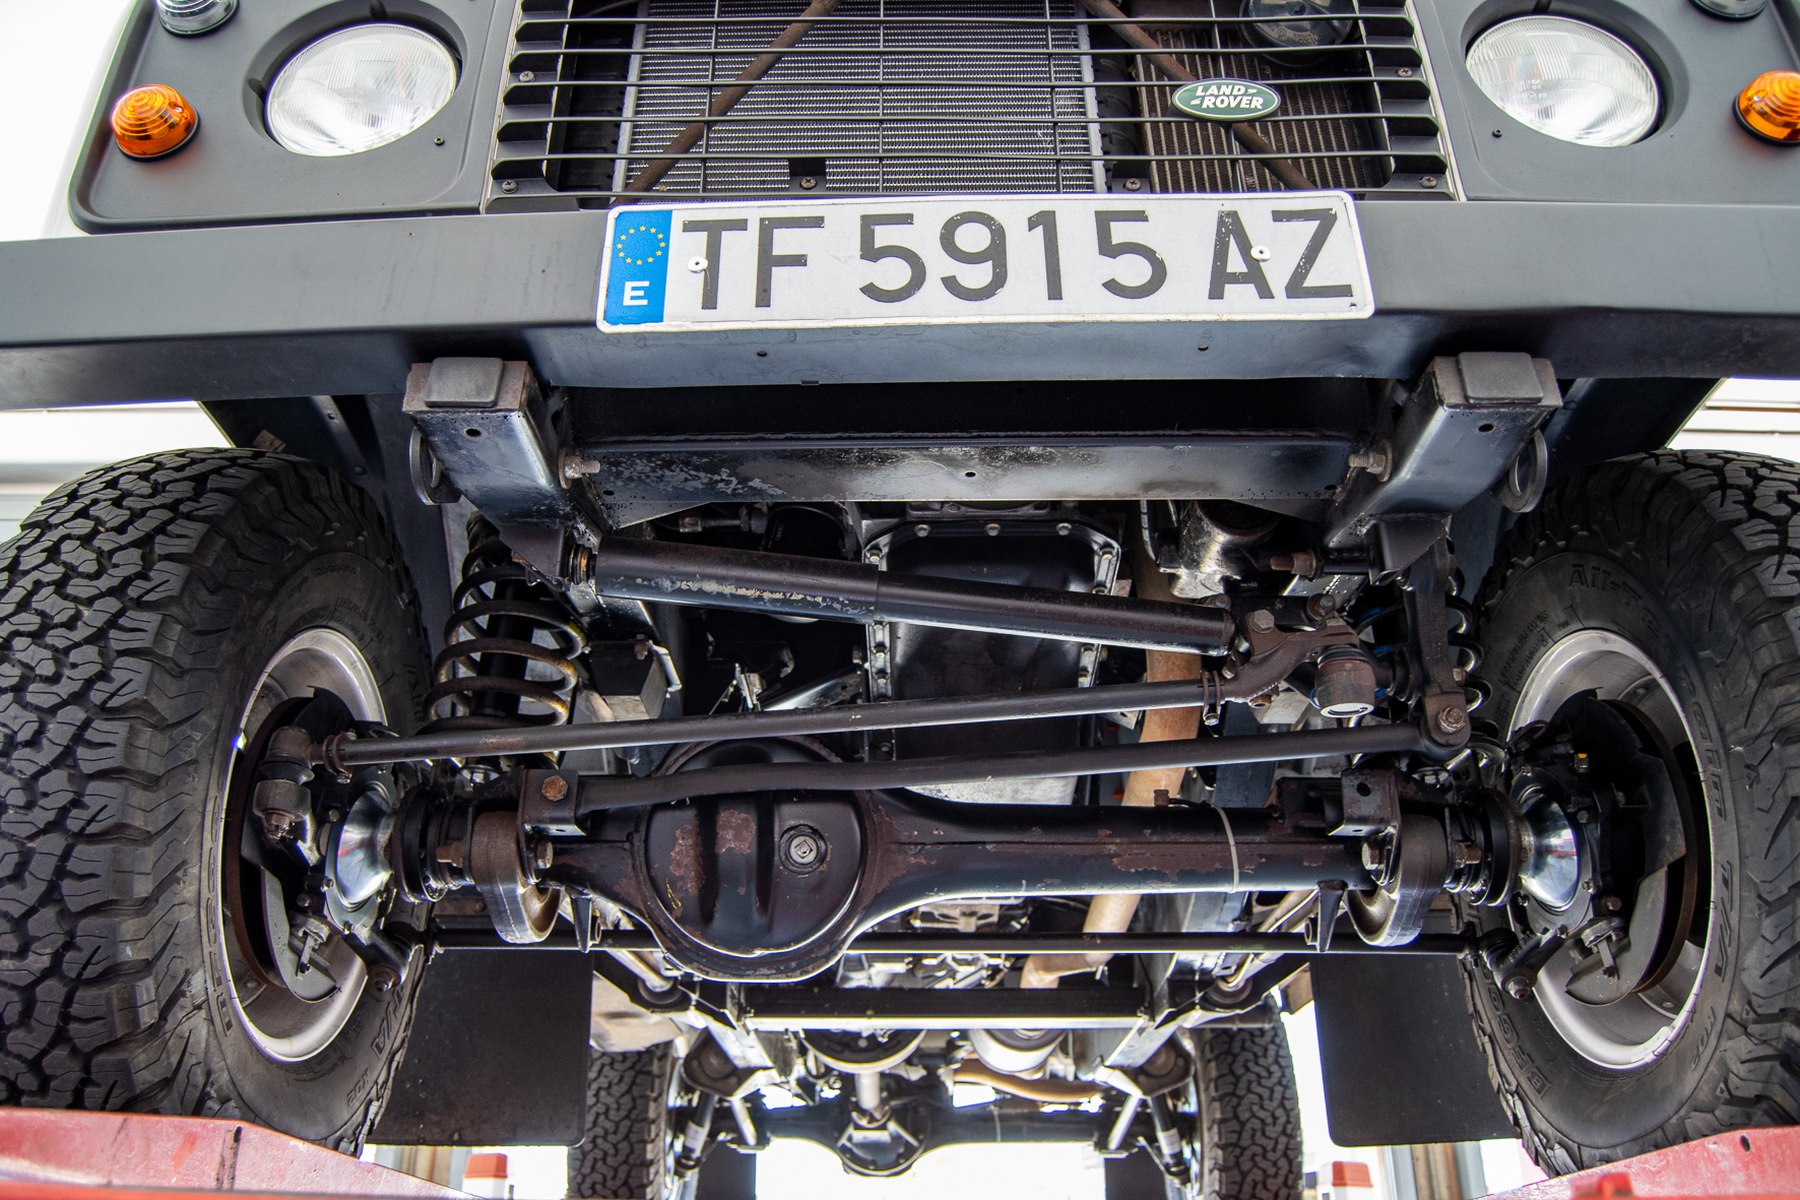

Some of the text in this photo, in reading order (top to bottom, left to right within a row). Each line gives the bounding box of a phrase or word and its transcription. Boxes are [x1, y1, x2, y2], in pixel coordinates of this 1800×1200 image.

[1195, 84, 1245, 96] LAND
[1201, 96, 1264, 109] ROVER
[682, 208, 1353, 310] TF 5915 AZ
[623, 280, 650, 306] E
